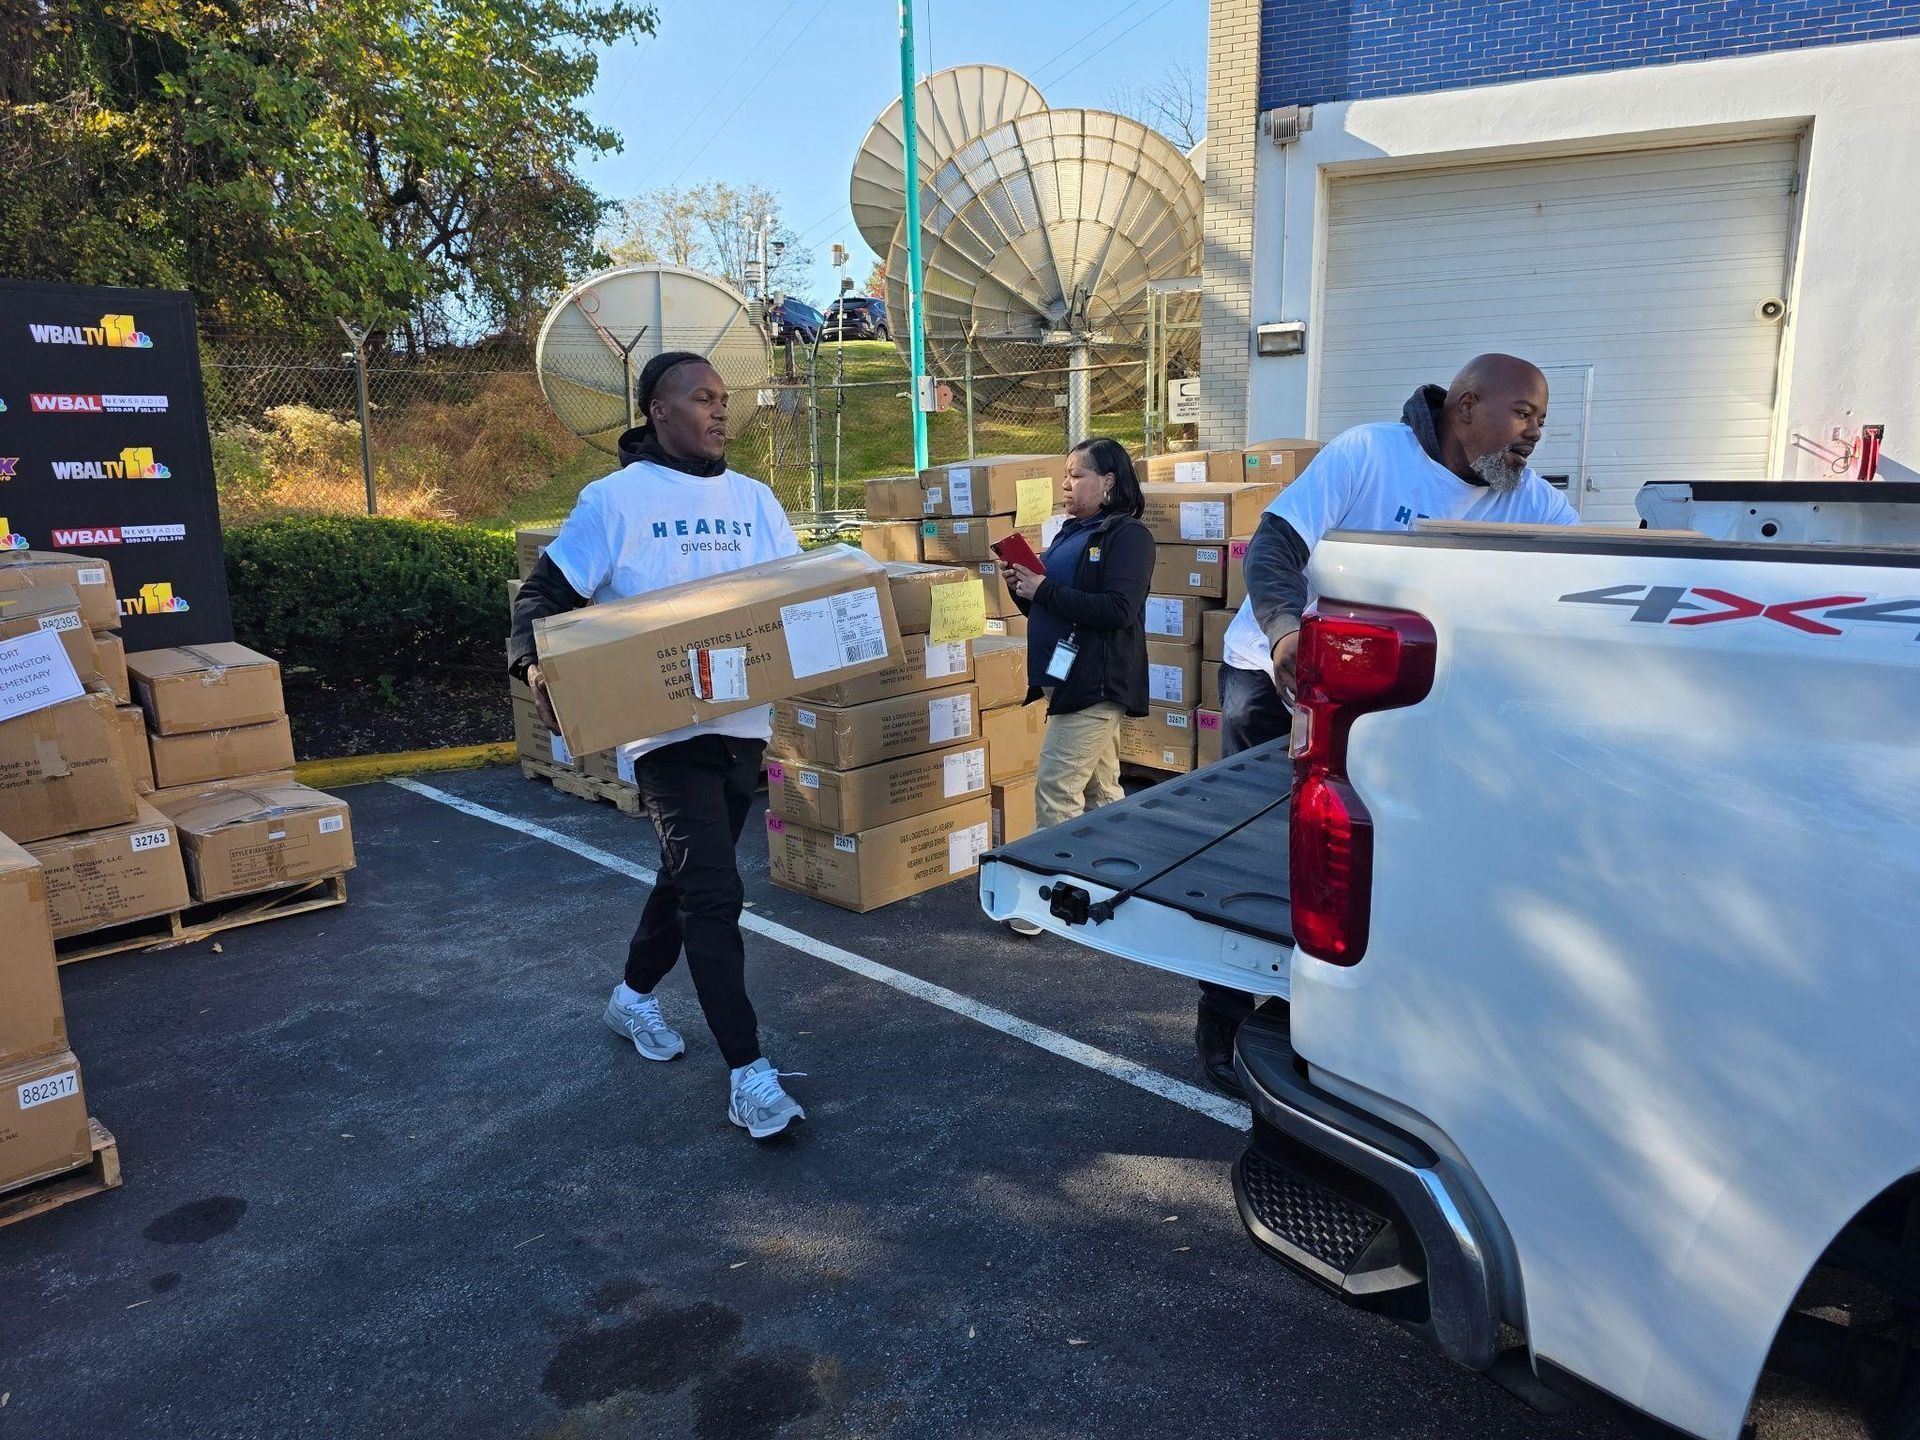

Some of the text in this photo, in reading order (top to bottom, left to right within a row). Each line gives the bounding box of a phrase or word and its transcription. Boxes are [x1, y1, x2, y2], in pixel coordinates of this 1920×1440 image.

[33, 395, 102, 411] WBAL
[652, 518, 752, 538] HEARST
[55, 529, 120, 545] WBAL
[681, 539, 742, 555] gives back
[41, 615, 80, 630] 882393
[656, 647, 678, 660] G&S
[681, 633, 732, 653] LOGISTICS
[661, 661, 678, 674] 205
[664, 673, 692, 687] KEAR
[3, 684, 51, 706] 16 BOXES
[1168, 714, 1185, 725] 32671
[1200, 716, 1216, 727] KLF
[768, 768, 782, 779] KLF
[769, 818, 784, 830] KLF
[135, 833, 166, 848] 32763
[835, 836, 853, 849] 32671
[22, 1075, 74, 1105] 882317
